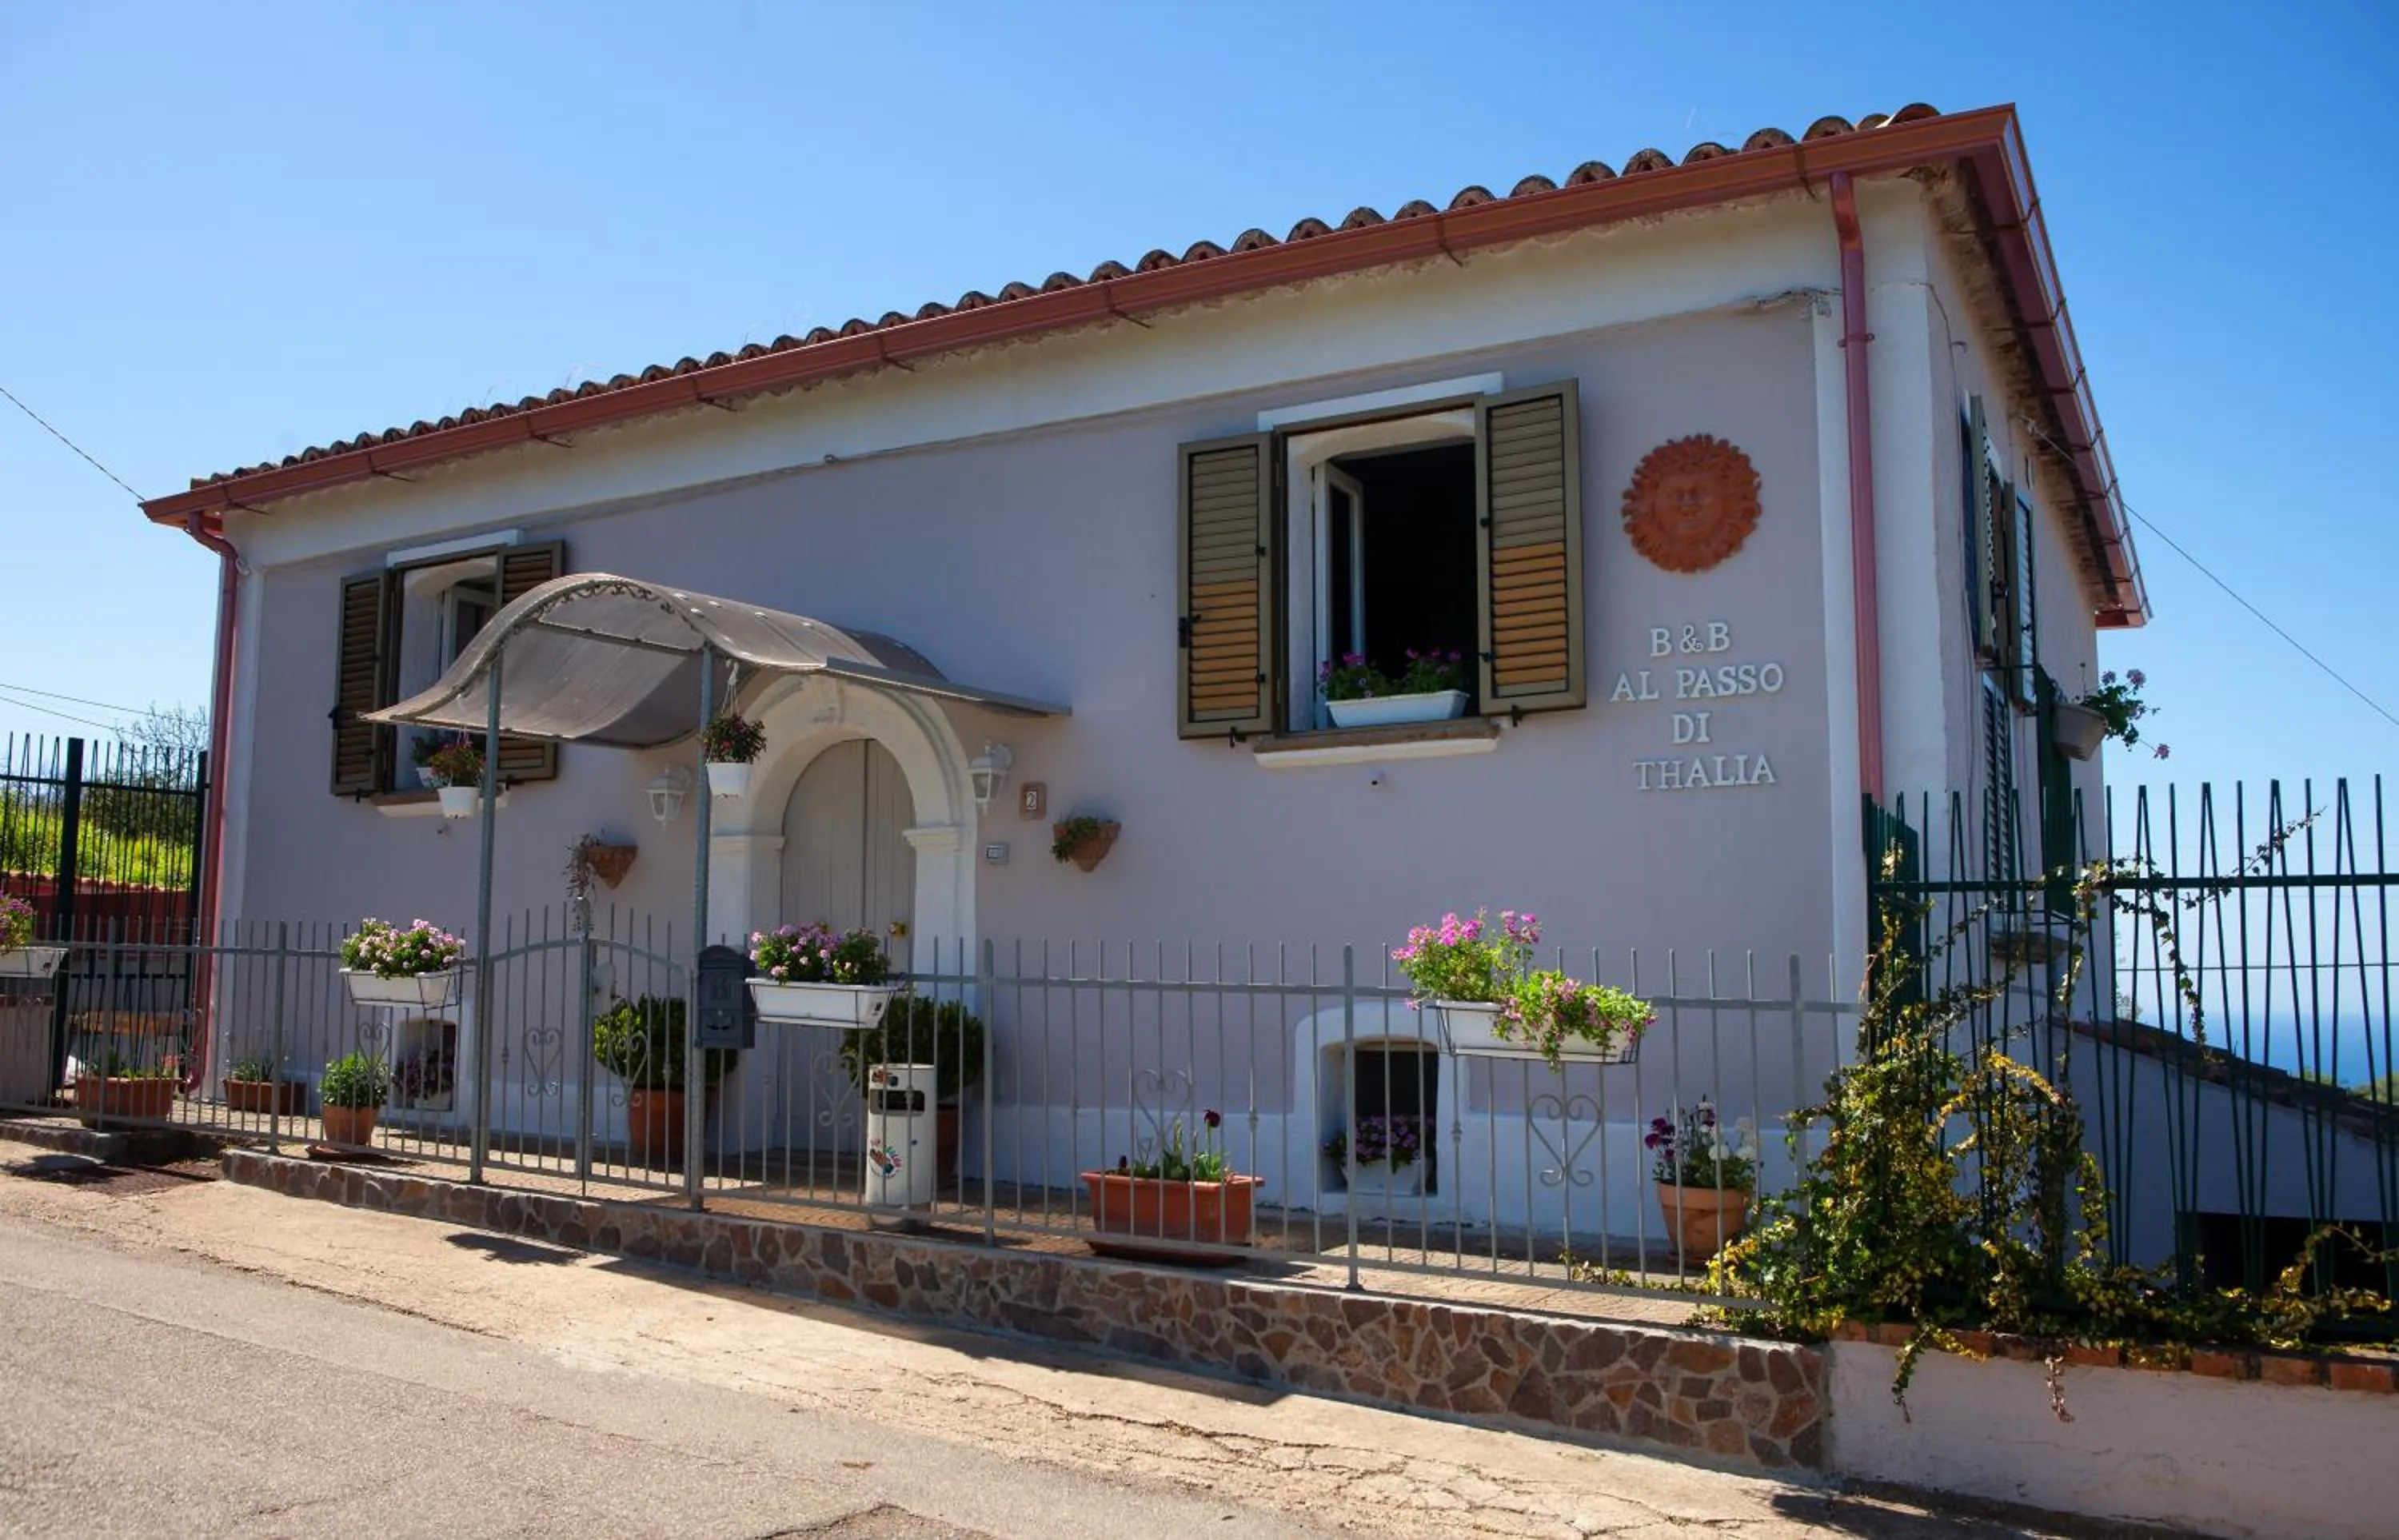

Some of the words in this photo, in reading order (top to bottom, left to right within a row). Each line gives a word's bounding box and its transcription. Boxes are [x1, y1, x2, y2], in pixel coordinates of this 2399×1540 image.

[1610, 671, 1659, 702] AL
[1675, 663, 1785, 699] PASSO
[1671, 712, 1710, 744] DI
[1633, 754, 1776, 790] THALIA
